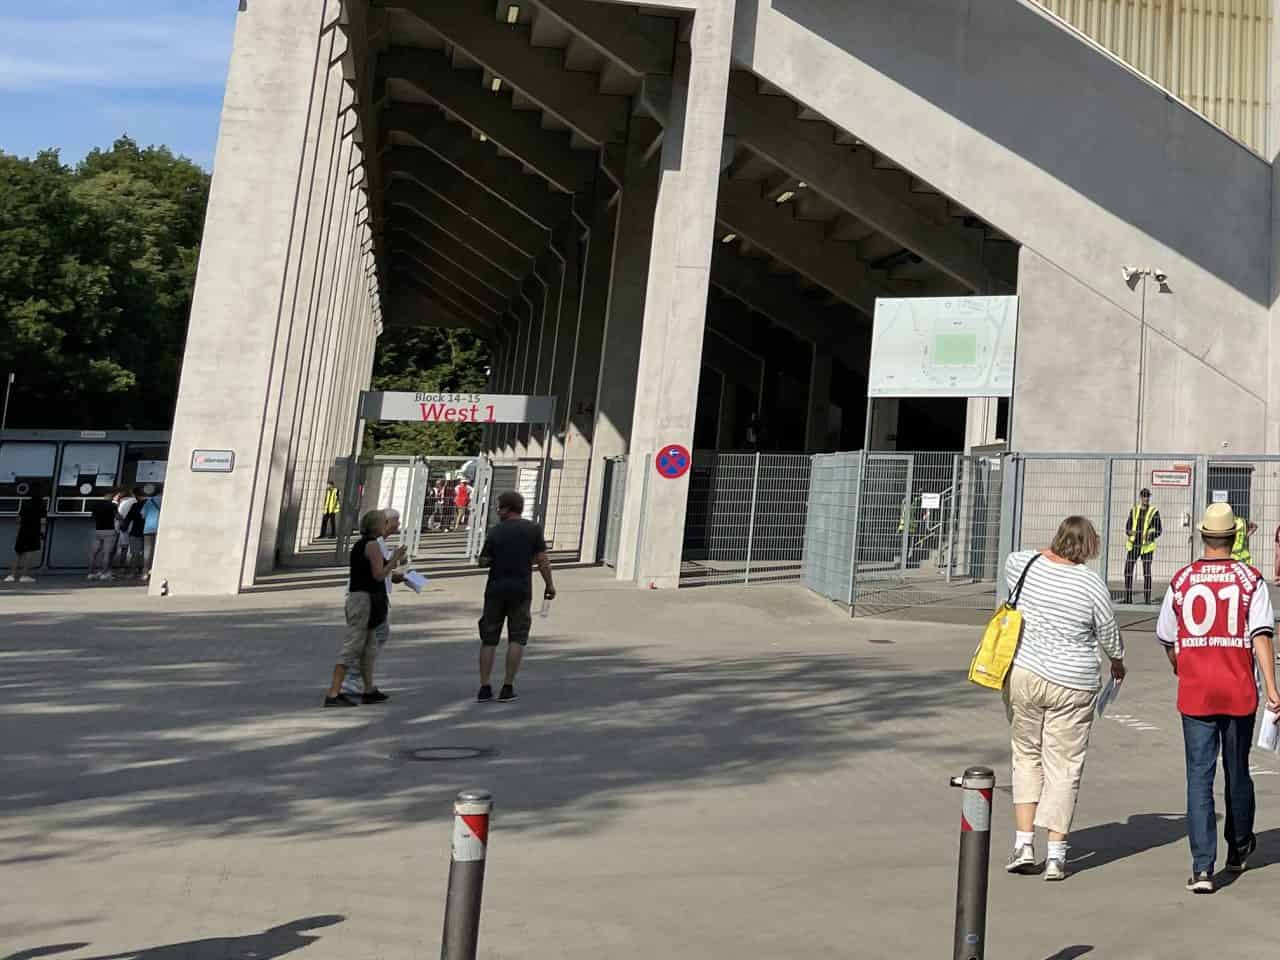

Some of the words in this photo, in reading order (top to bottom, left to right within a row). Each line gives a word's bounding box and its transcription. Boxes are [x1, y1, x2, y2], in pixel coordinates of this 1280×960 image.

[414, 392, 446, 402] Block
[419, 402, 479, 423] West
[484, 405, 497, 424] 1
[1182, 583, 1241, 637] 01
